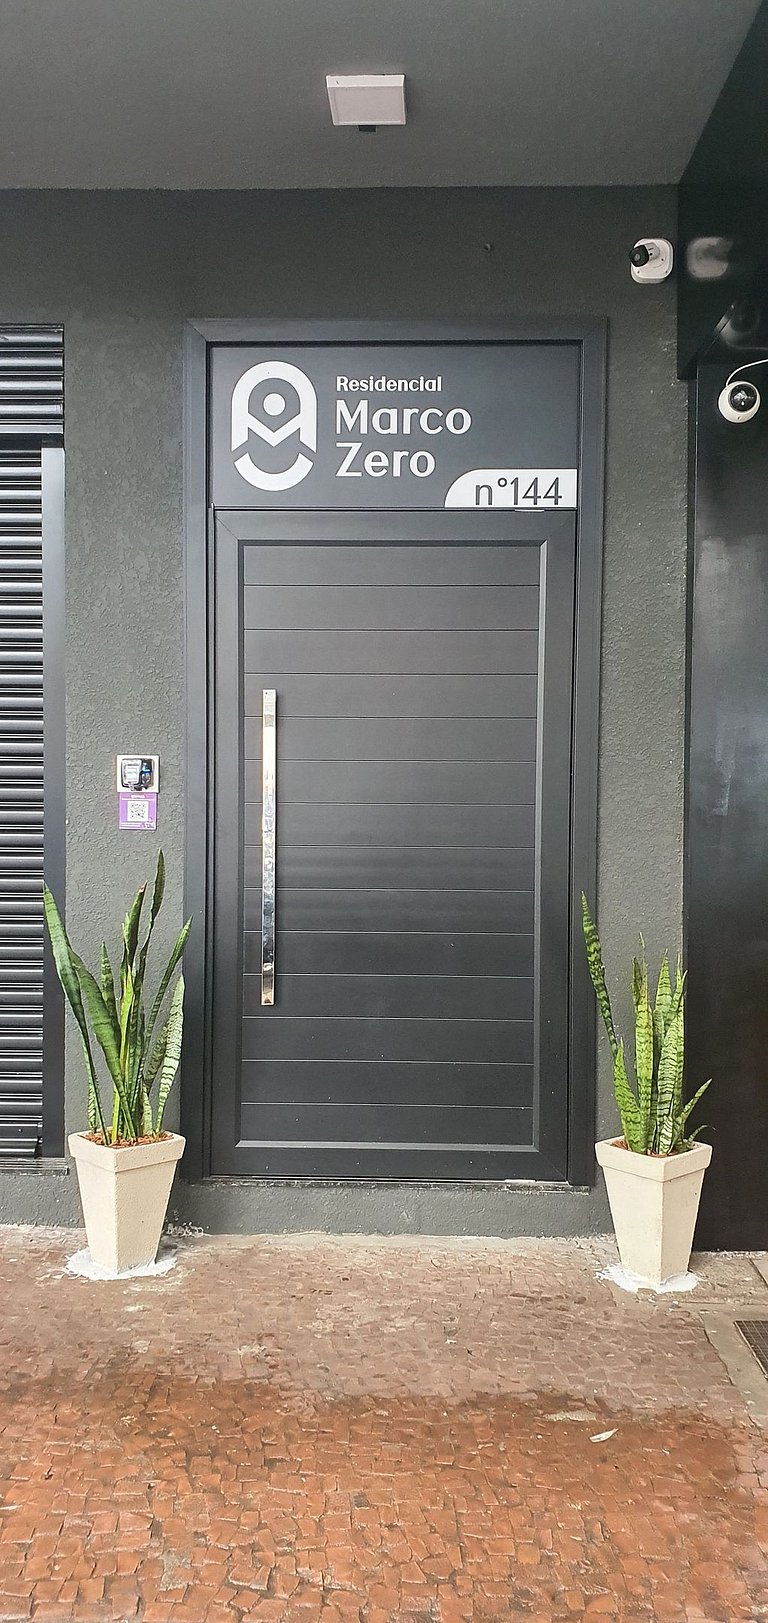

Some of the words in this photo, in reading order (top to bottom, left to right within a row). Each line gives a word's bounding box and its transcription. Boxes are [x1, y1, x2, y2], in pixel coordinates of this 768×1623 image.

[336, 375, 442, 392] Residencial
[336, 399, 472, 435] Marco
[335, 442, 435, 478] Zero
[475, 476, 563, 506] n°144
